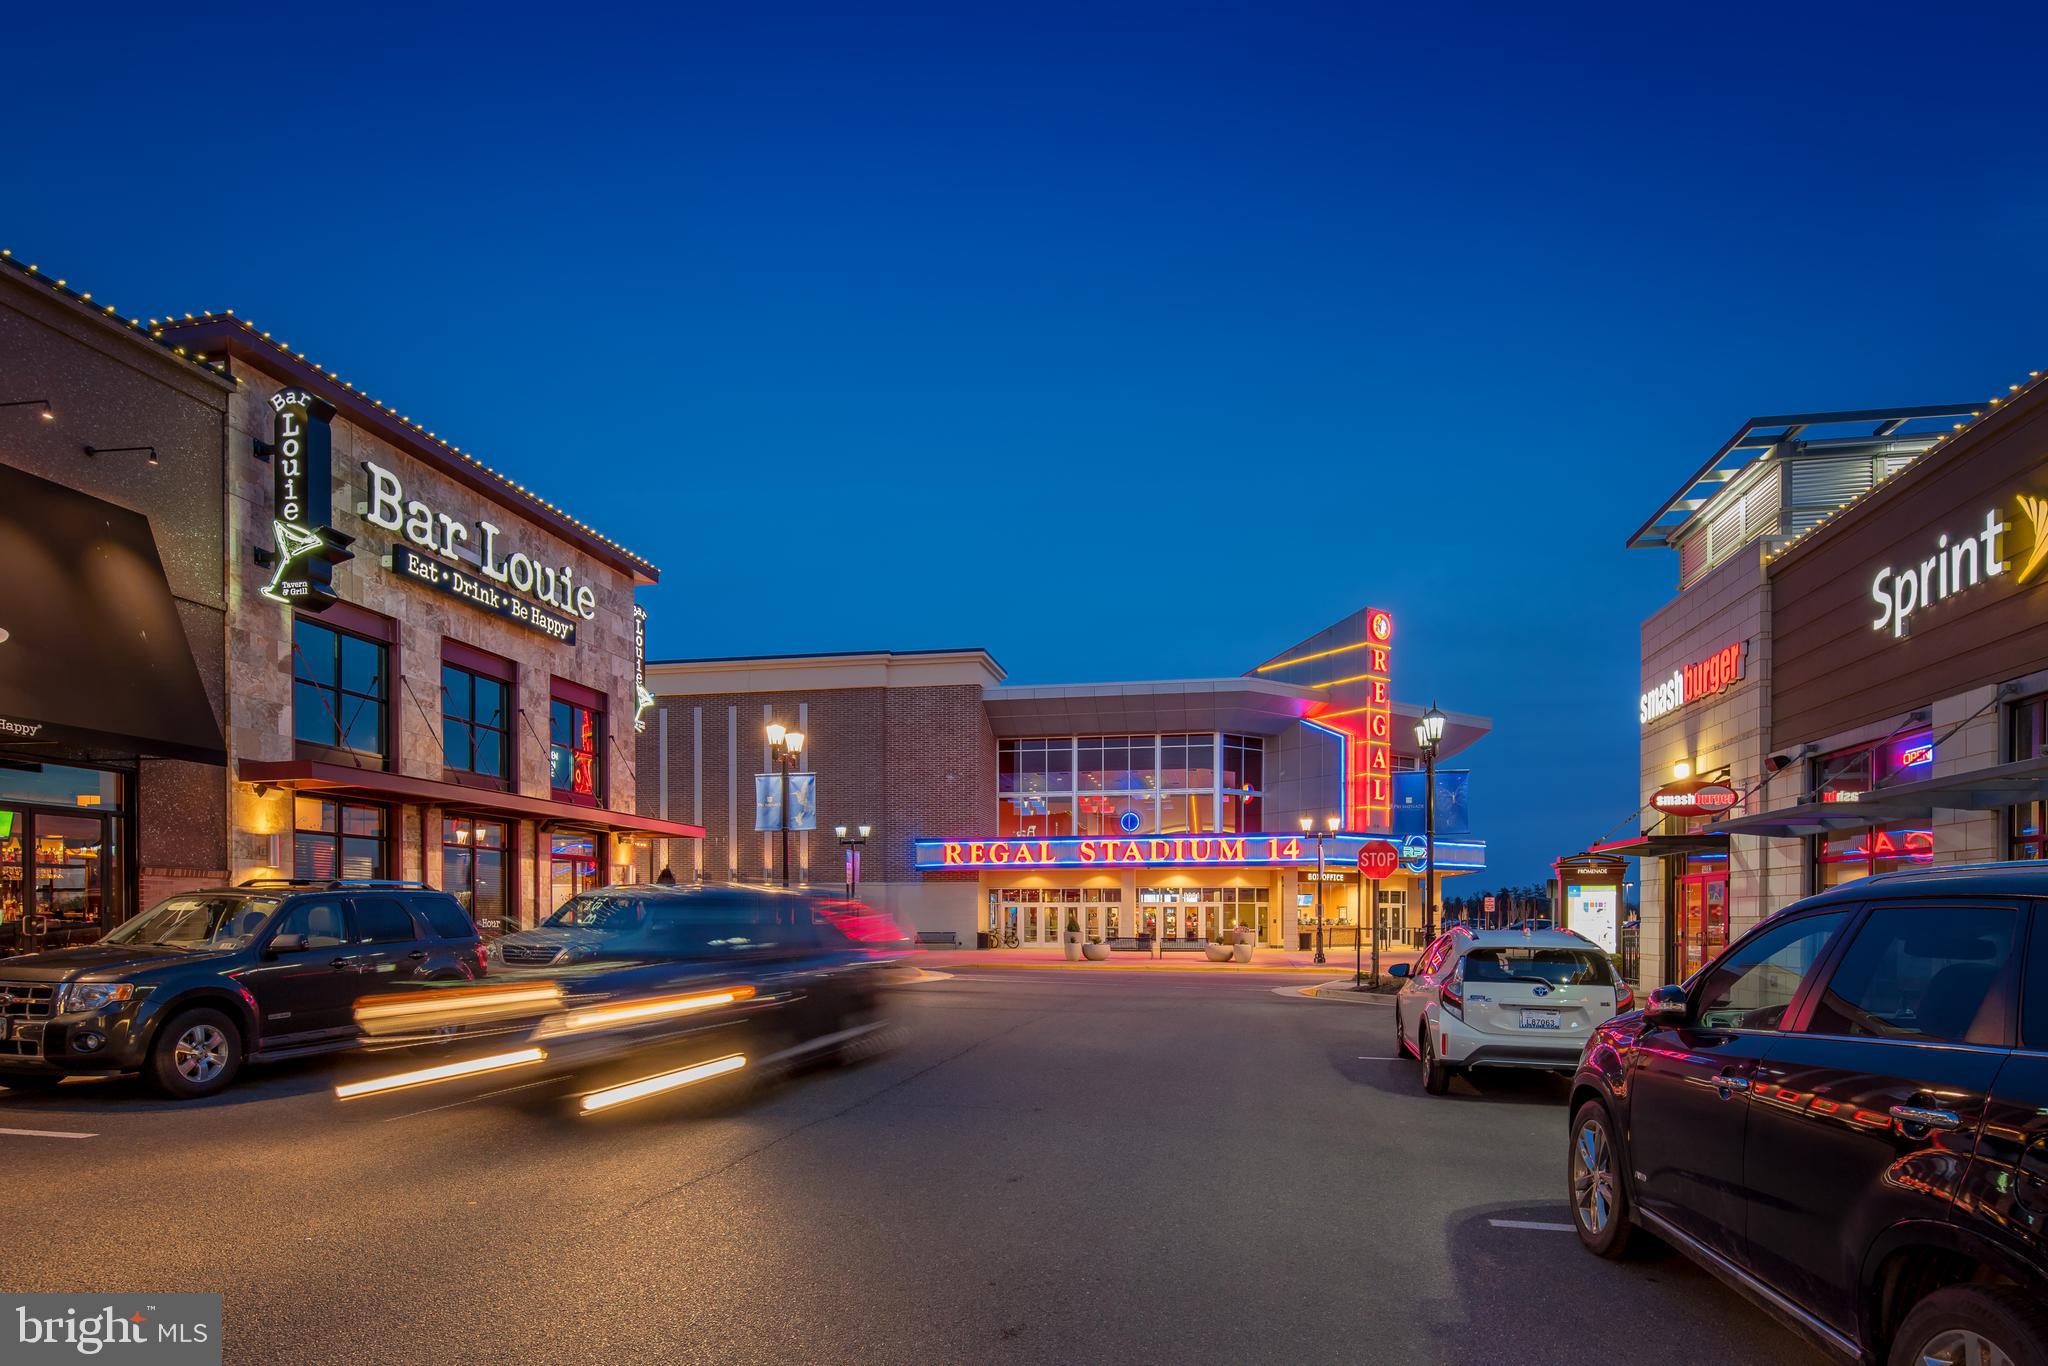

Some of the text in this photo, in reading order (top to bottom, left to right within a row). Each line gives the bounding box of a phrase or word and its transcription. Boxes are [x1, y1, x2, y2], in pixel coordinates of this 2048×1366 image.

[271, 391, 311, 411] Bar
[282, 413, 301, 521] Louie
[366, 461, 596, 620] Bar Louie
[1872, 508, 2003, 638] Sprint
[282, 581, 308, 589] Tavern
[407, 553, 439, 583] Eat
[452, 571, 500, 609] Drink
[511, 597, 529, 620] Be
[635, 619, 643, 685] Louie
[1640, 642, 1740, 724] smashburger
[1373, 648, 1387, 800] REGAL
[1656, 791, 1735, 806] smashburger
[944, 838, 1301, 865] REGAL STADIUM 14
[1360, 852, 1396, 867] STOP
[482, 918, 500, 928] Hour
